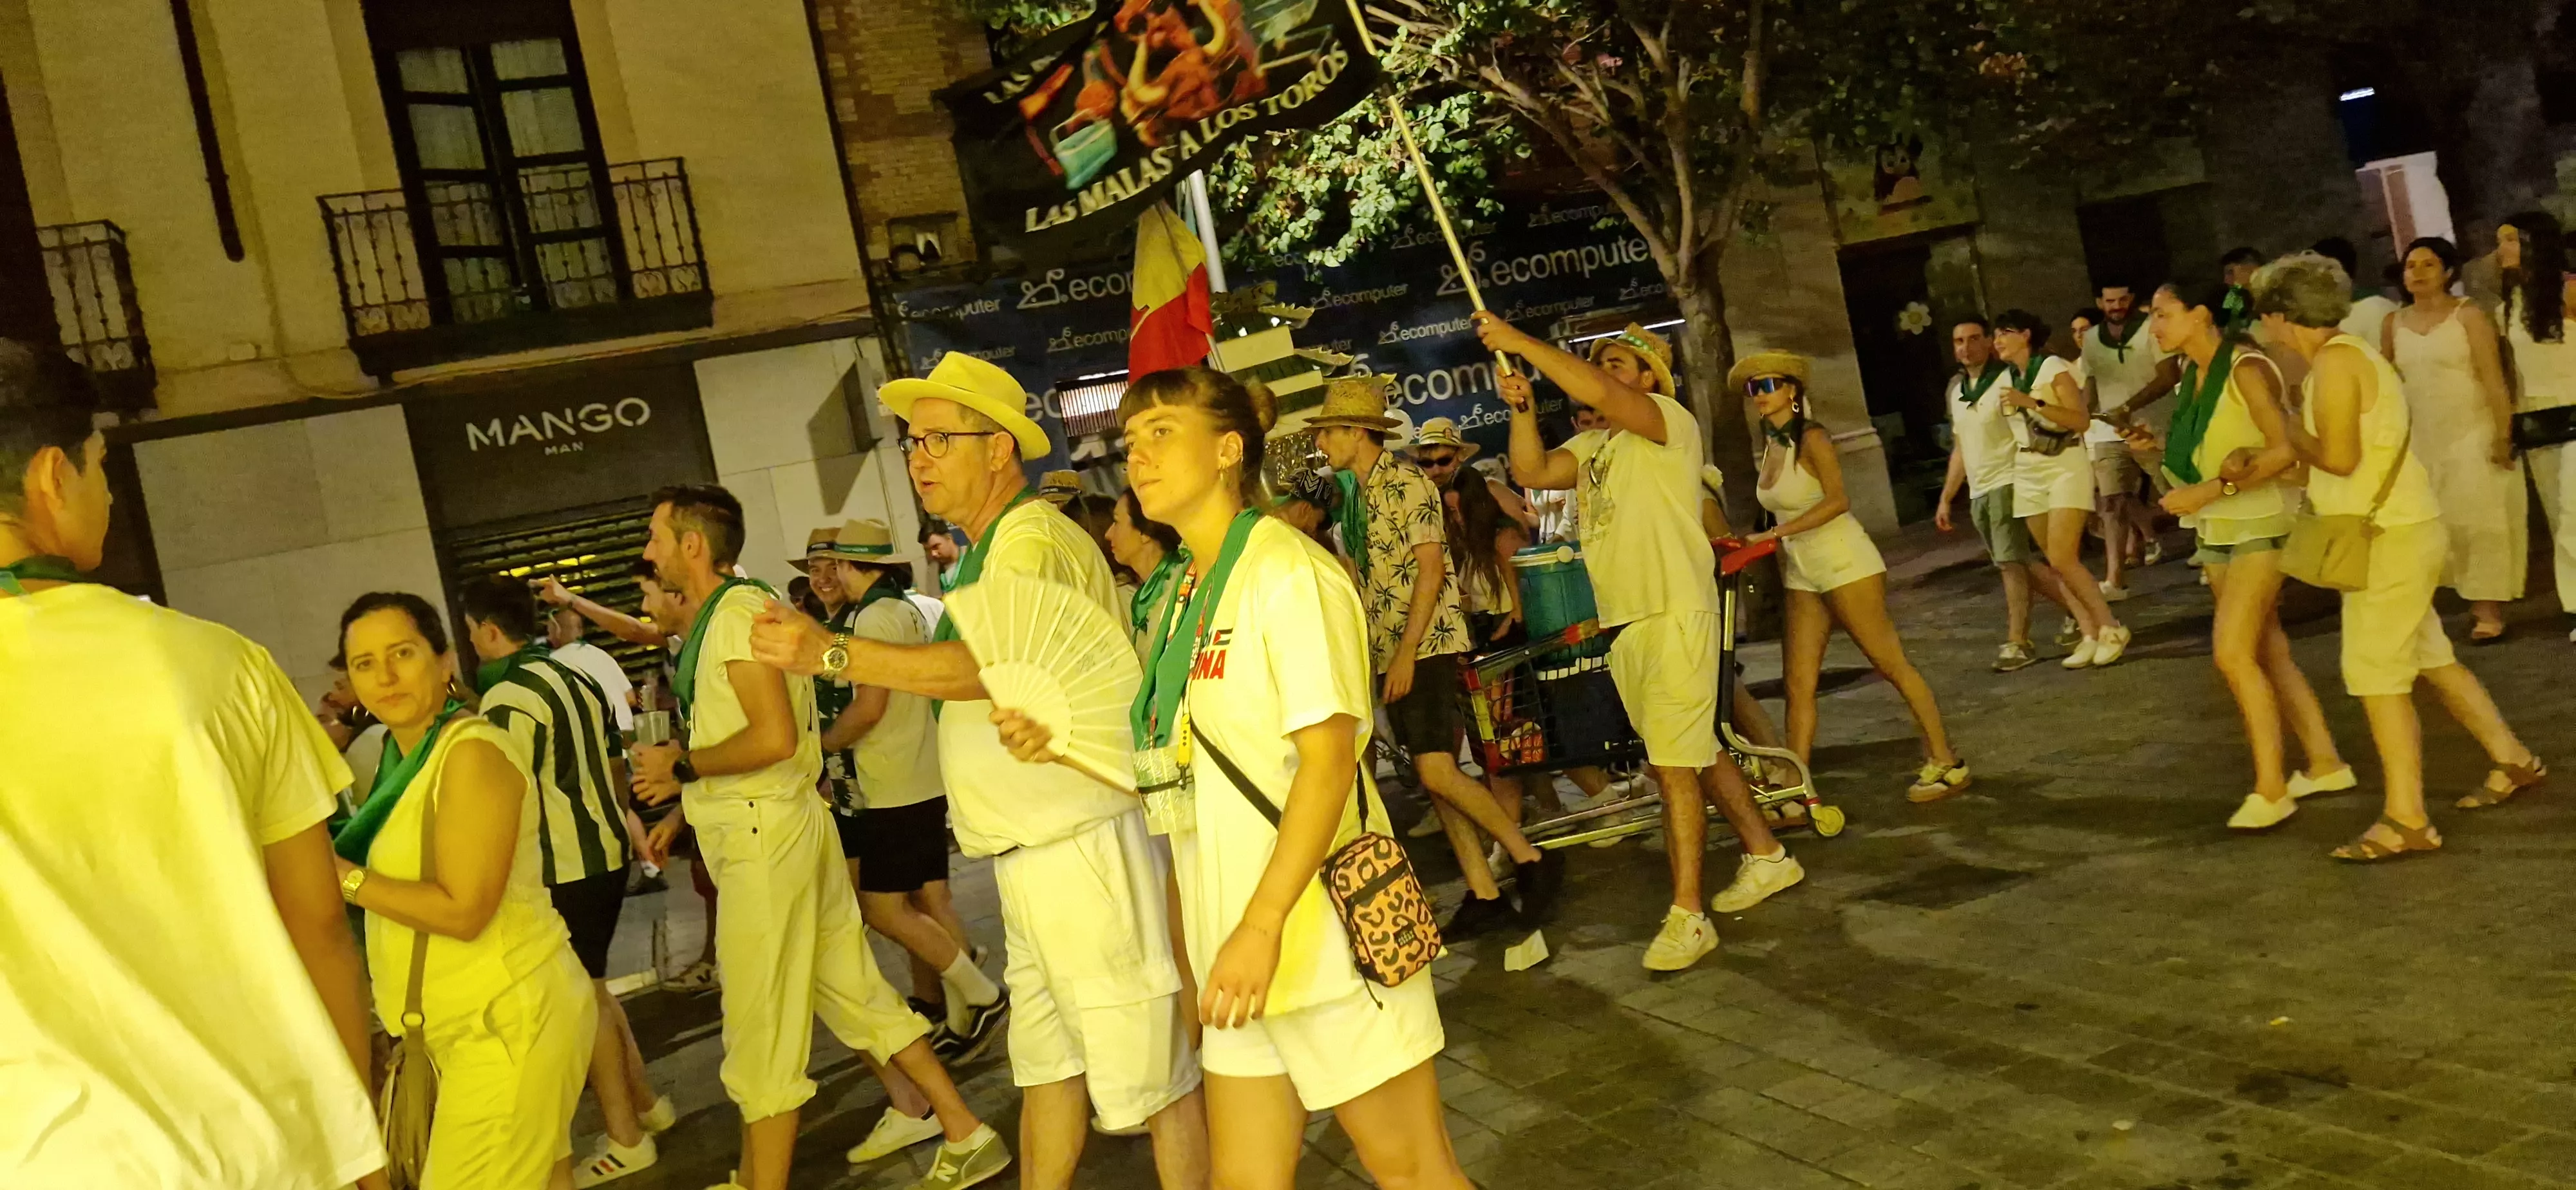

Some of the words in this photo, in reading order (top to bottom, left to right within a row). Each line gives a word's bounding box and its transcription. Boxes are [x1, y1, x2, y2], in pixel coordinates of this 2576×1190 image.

[1025, 198, 1078, 233] LAS
[1077, 144, 1177, 216] MALAS
[1180, 129, 1202, 160] A
[1198, 102, 1258, 144] LOS
[1260, 39, 1349, 116] TOROS
[1490, 234, 1649, 286] ecompute
[1331, 283, 1408, 306] ecomputer
[466, 397, 650, 451] MANGO
[544, 441, 584, 456] MAN
